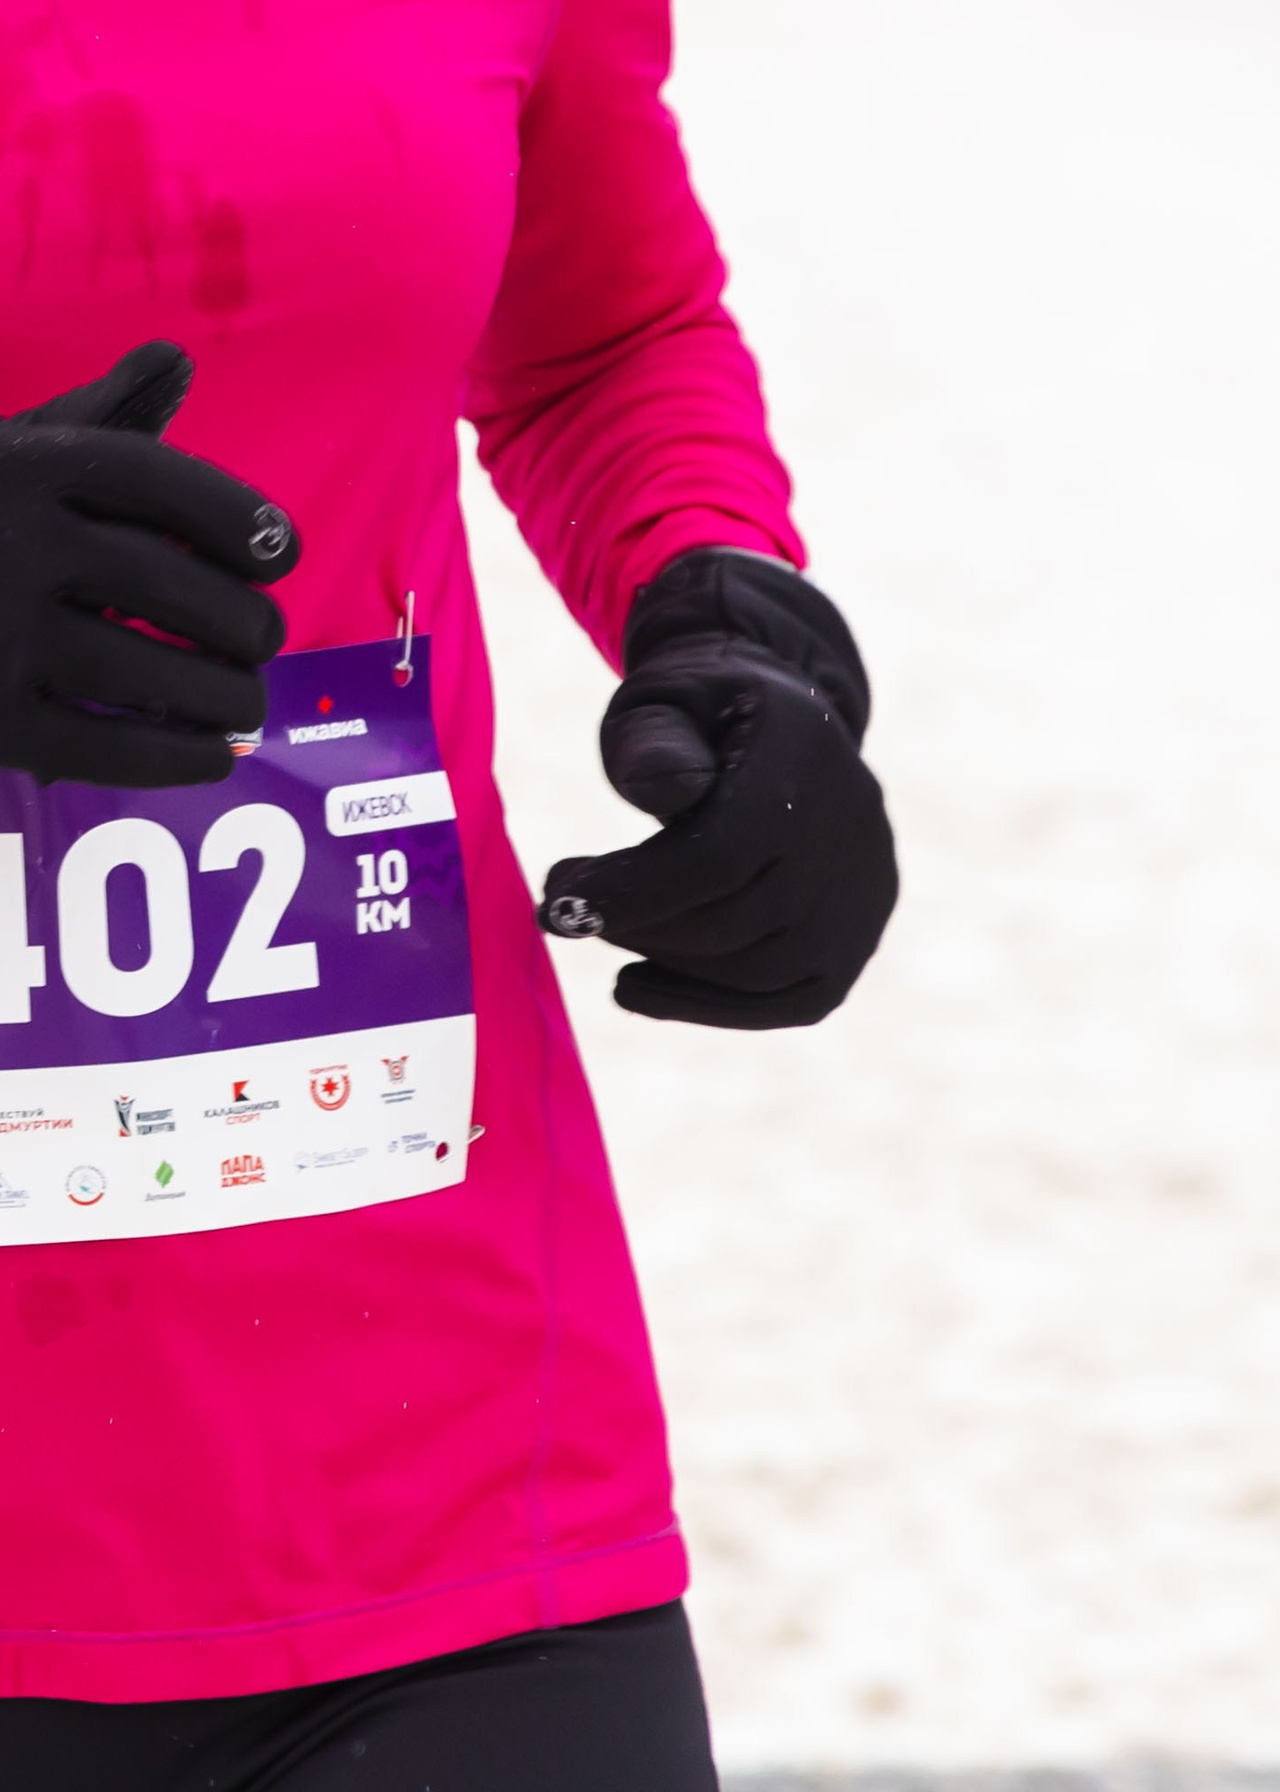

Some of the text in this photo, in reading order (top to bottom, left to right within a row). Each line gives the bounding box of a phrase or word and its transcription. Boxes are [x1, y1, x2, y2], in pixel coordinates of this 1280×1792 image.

[287, 717, 369, 746] ижавиа
[342, 791, 412, 824] ИЖЕВСК
[355, 848, 409, 899] 10
[356, 896, 412, 935] КМ
[203, 1099, 281, 1119] КАЛАШНИКОВ
[225, 1112, 261, 1126] СПОРТ
[220, 1154, 265, 1176] ПАПА
[220, 1171, 267, 1189] ДЖОНС
